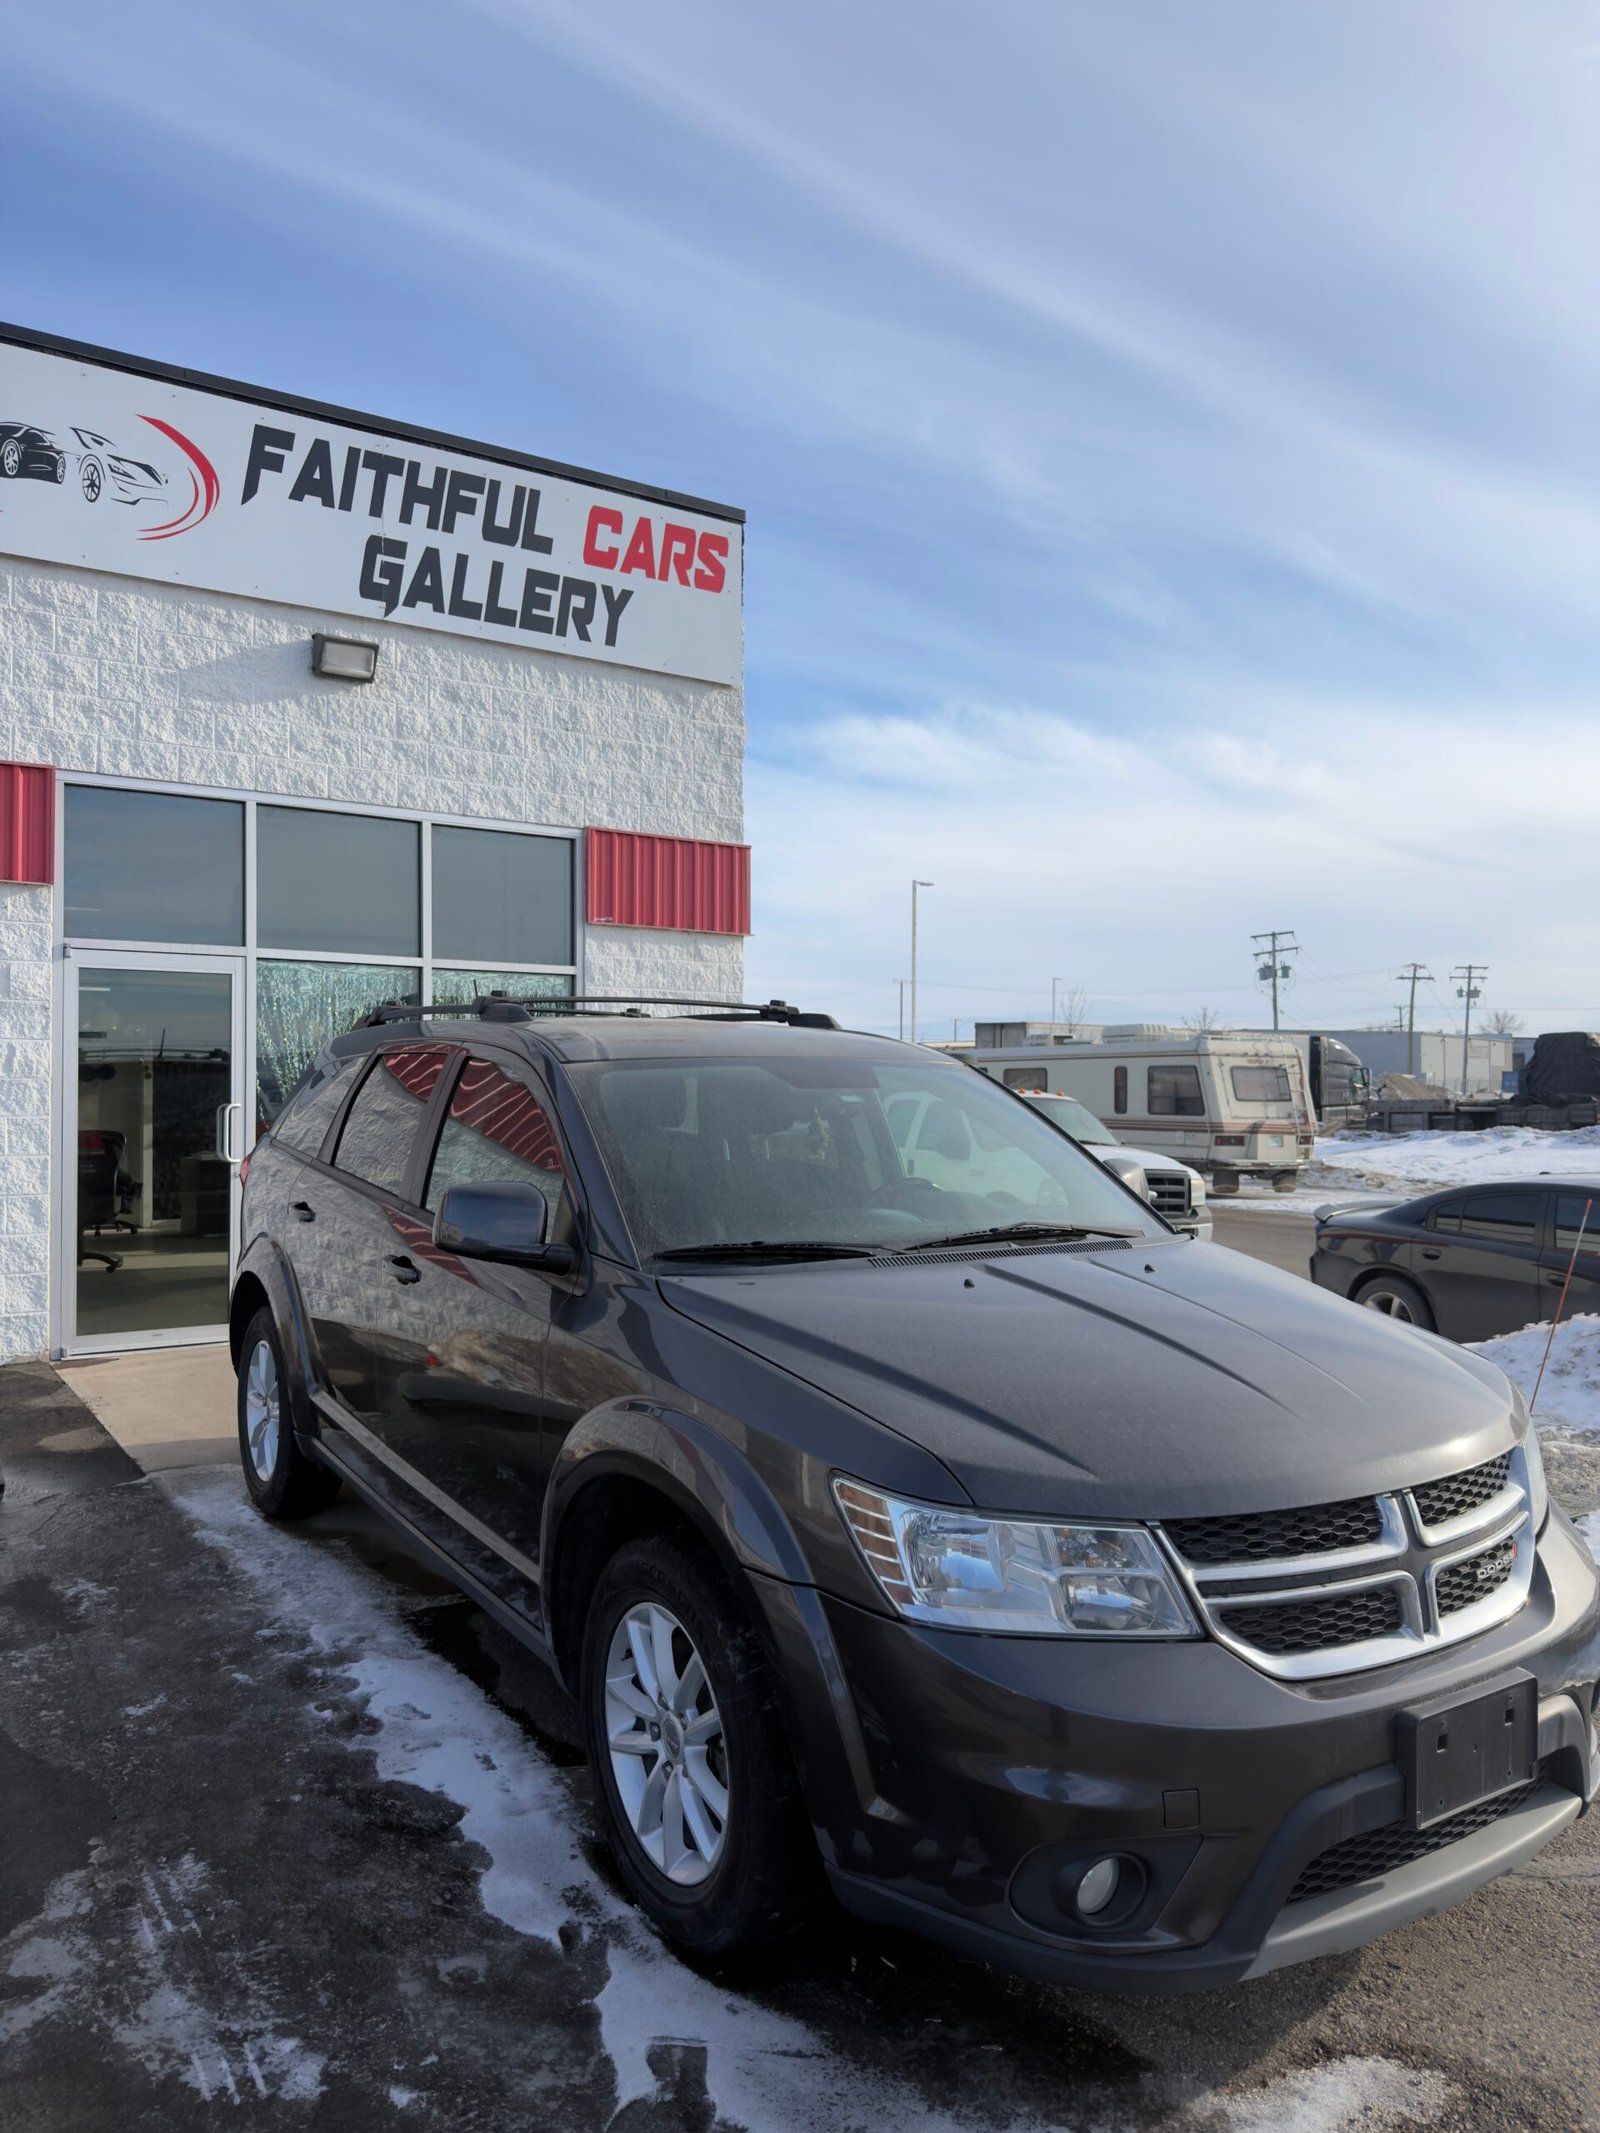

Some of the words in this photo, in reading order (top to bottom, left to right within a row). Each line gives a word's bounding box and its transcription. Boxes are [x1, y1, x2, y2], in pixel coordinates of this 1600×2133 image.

[241, 424, 554, 555] FAITHFUL
[583, 505, 729, 594] CARS
[359, 534, 634, 647] GALLERY
